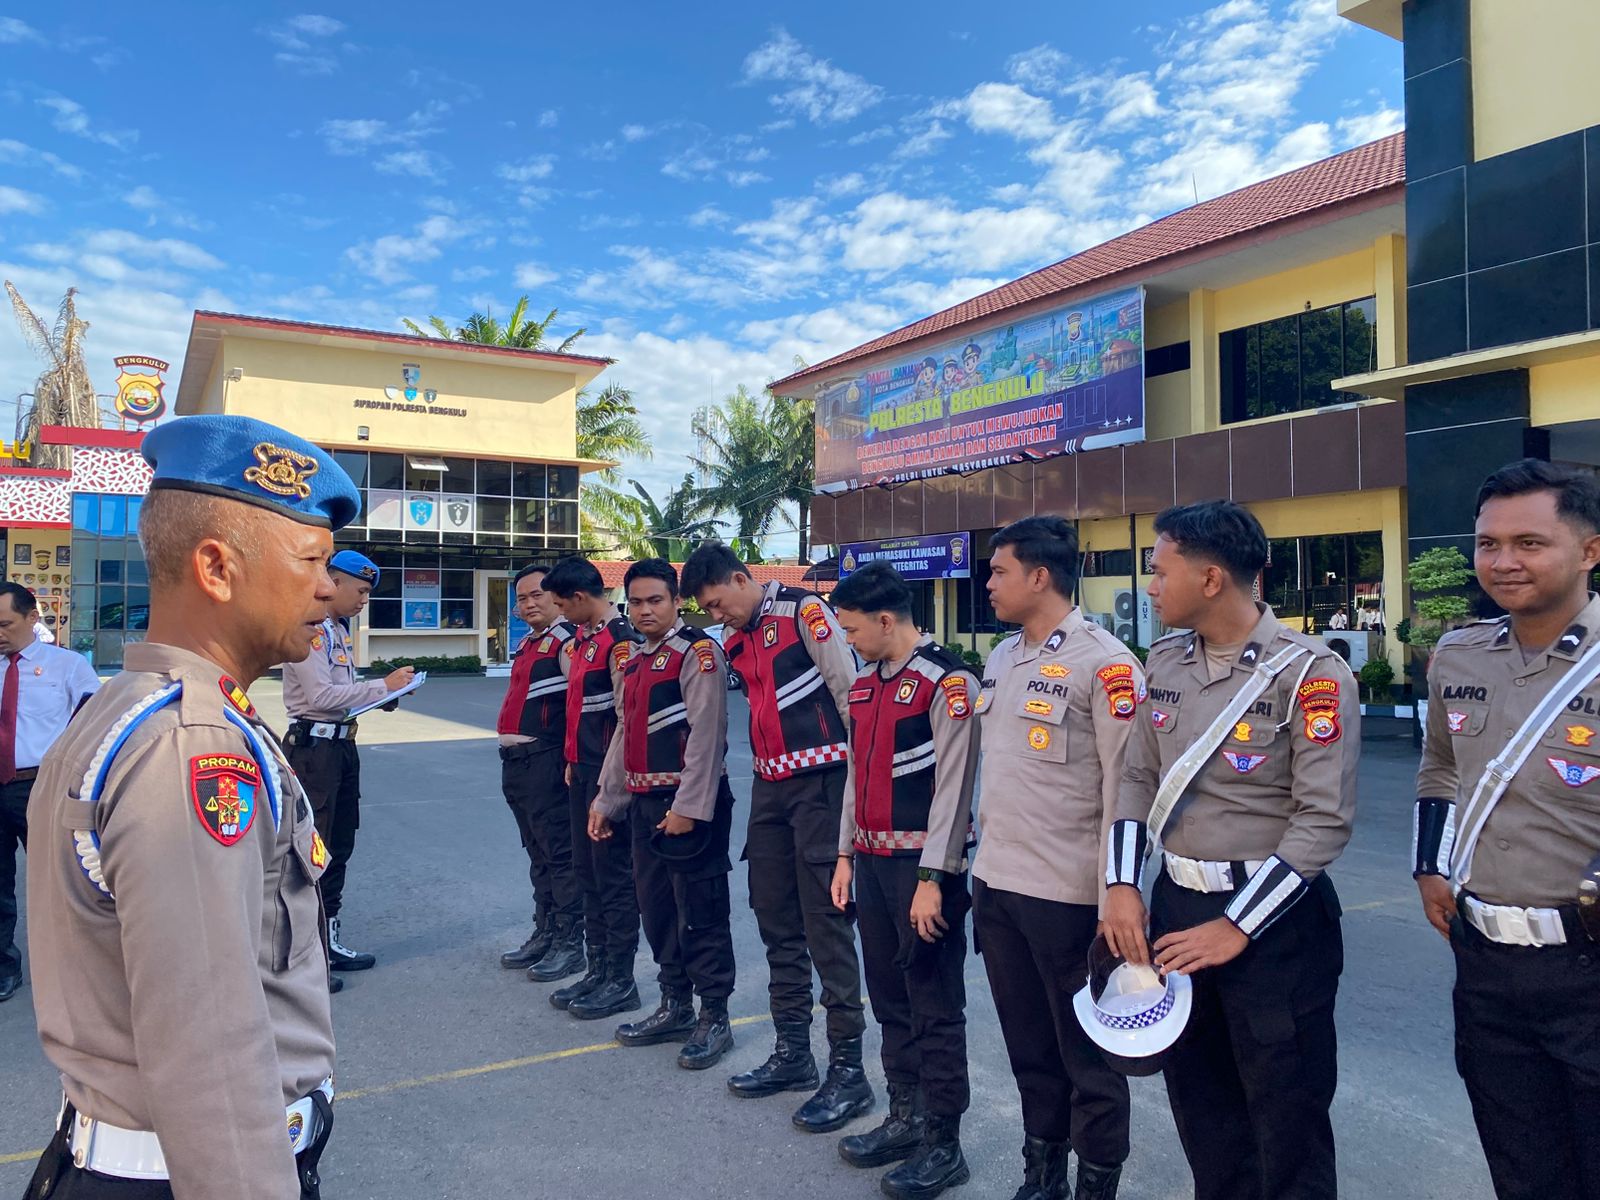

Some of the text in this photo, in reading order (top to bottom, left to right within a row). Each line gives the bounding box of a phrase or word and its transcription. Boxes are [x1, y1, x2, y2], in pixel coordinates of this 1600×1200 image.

[117, 358, 166, 369] BENGKULU
[869, 369, 1044, 432] POLRESTA BENGKULU
[392, 402, 427, 414] POLRESTA
[428, 406, 467, 417] BENGKULU
[857, 440, 892, 460] BEKERJA
[892, 432, 927, 452] DENGAN
[951, 420, 985, 441] UNTUK
[985, 402, 1063, 434] MEWUJUDKAN
[862, 454, 904, 475] BENGKULU
[965, 438, 987, 456] DAN
[987, 424, 1057, 452] SEJAHTERAH
[895, 470, 919, 482] POLRI
[858, 546, 946, 562] ANDA MEMASUKI KAWASAN
[1027, 680, 1069, 698] POLRI
[198, 757, 256, 774] PROPAM
